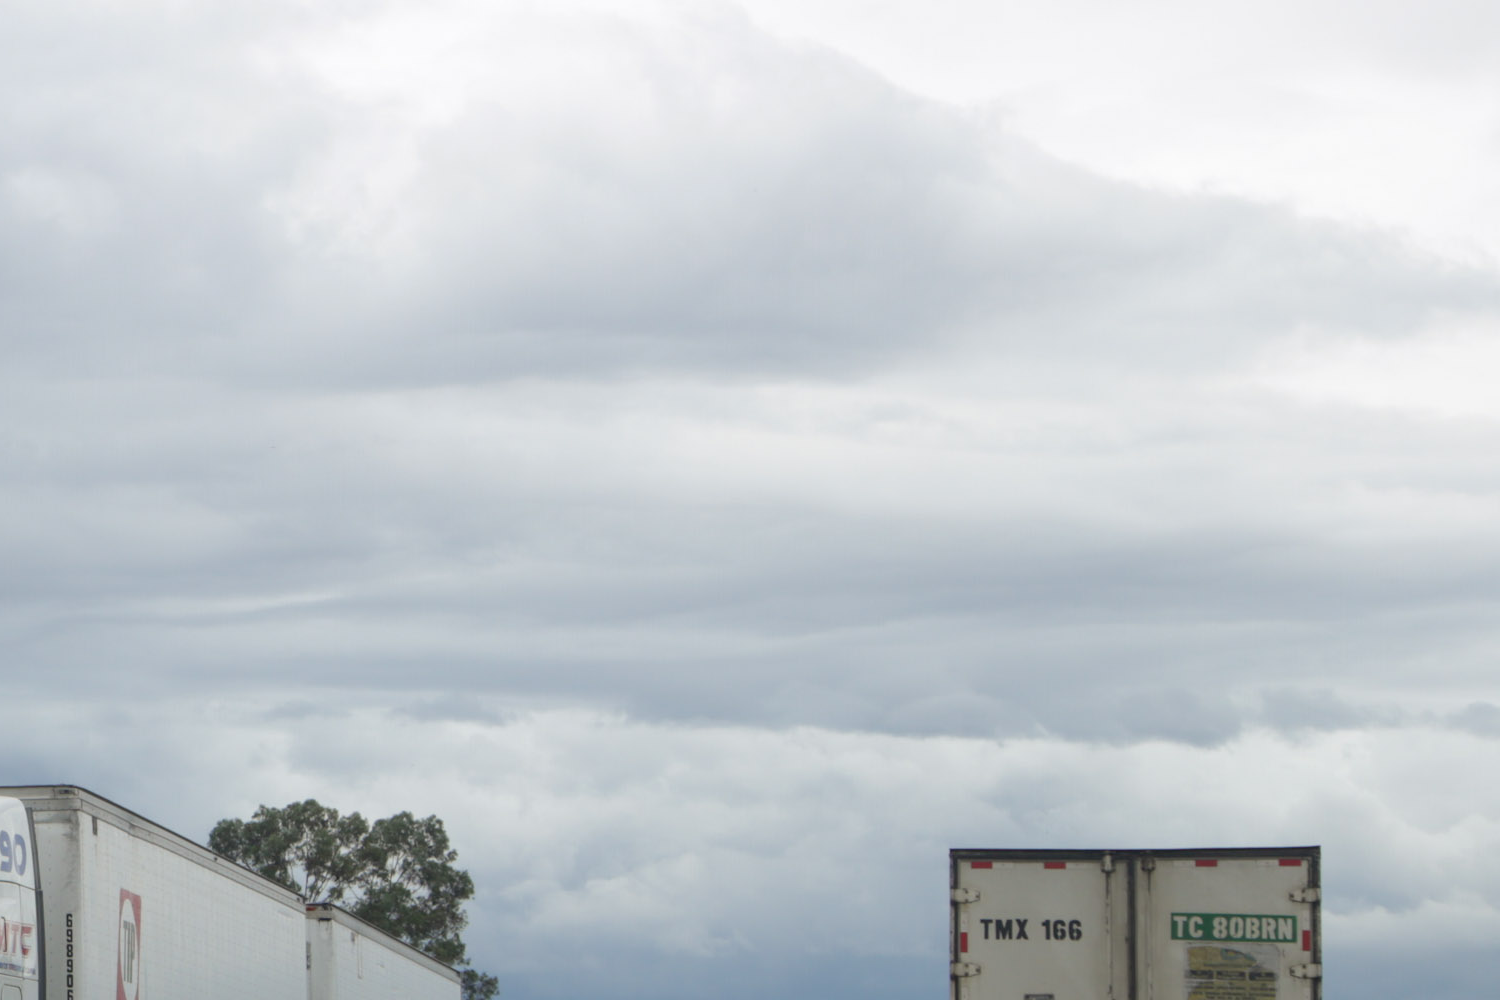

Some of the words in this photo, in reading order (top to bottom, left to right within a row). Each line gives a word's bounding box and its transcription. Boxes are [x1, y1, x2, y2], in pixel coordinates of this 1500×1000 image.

[980, 919, 1029, 940] TMX
[1041, 919, 1083, 941] 166
[1173, 915, 1204, 938] TC
[1212, 916, 1293, 940] 80BRN
[123, 919, 136, 983] TIP
